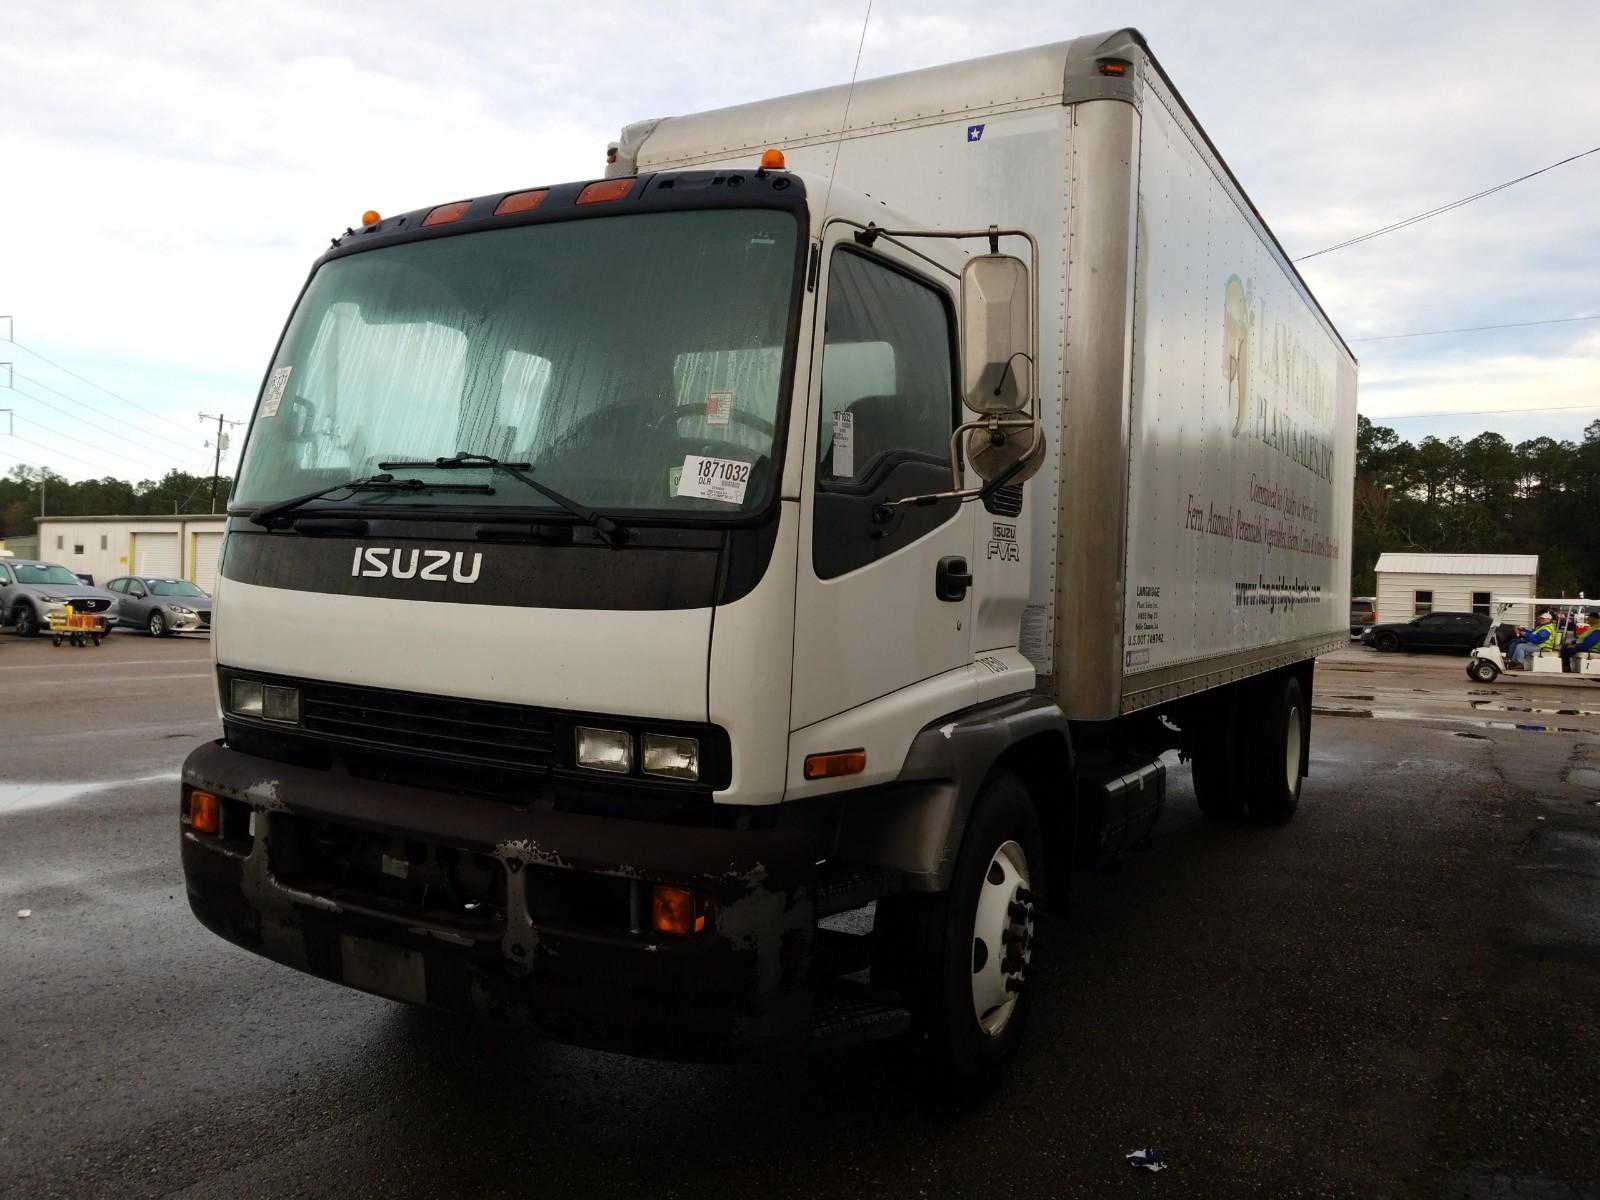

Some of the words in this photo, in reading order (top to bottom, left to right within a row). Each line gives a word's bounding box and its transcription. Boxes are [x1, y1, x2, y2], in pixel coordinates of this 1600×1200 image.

[697, 460, 749, 482] 1871032
[993, 526, 1016, 539] ISUZU
[987, 540, 1020, 562] FVR
[351, 546, 483, 584] ISUZU
